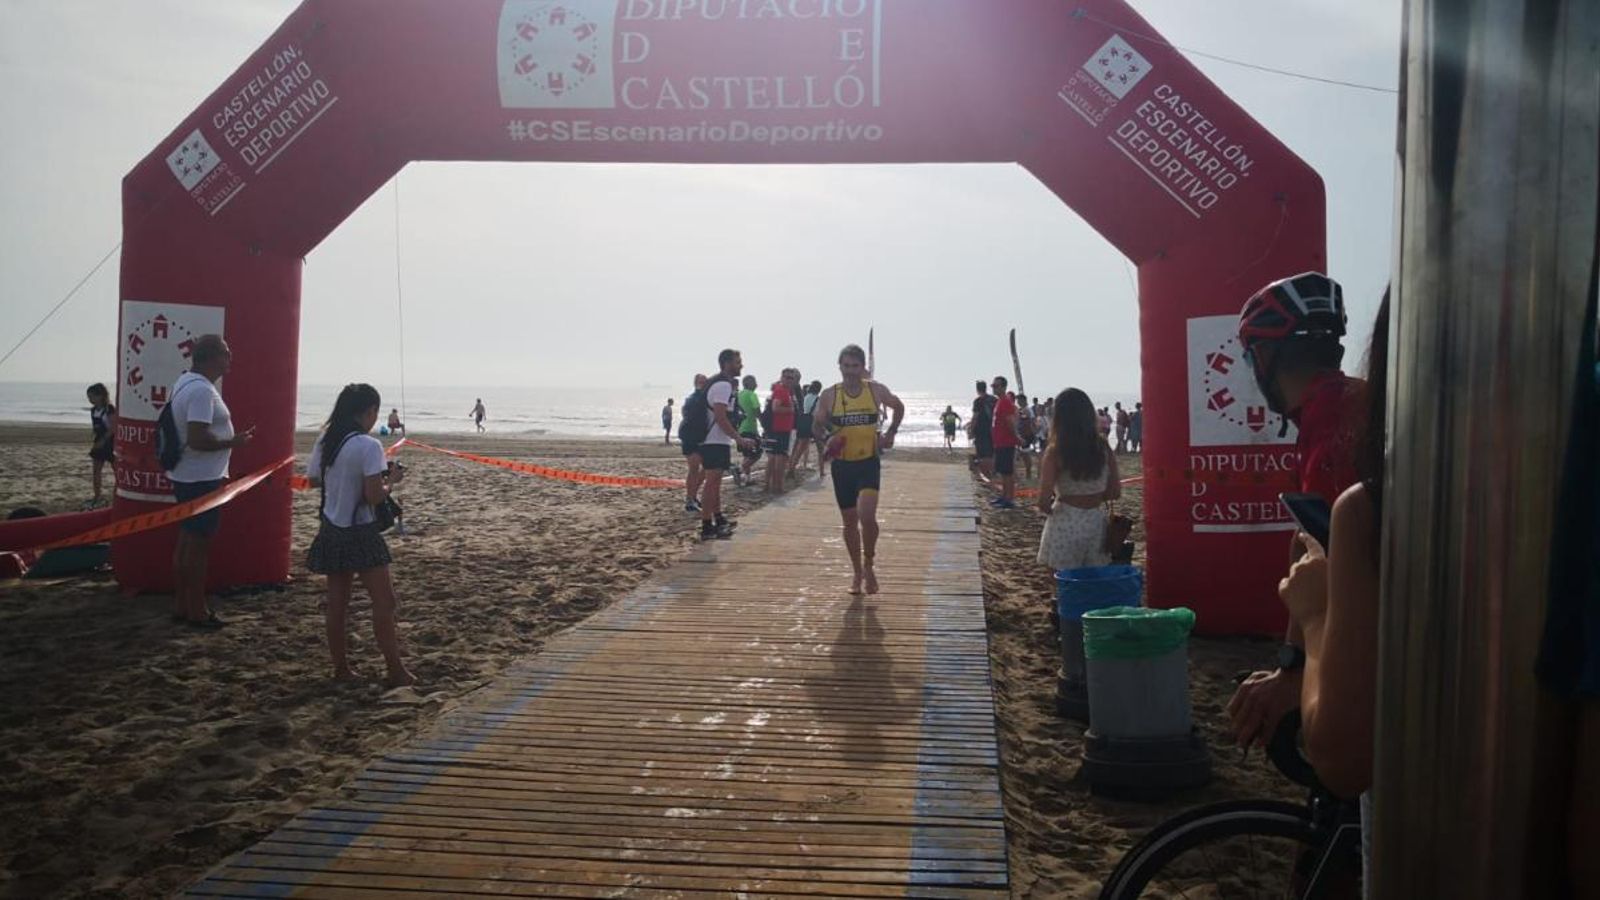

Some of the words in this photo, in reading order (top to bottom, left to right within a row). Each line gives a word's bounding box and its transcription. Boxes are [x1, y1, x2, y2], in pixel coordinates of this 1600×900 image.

[212, 44, 303, 129] CASTELLÓN,
[620, 32, 650, 63] D
[839, 29, 865, 61] E
[620, 65, 866, 110] CASTELLÓ
[223, 61, 312, 147] ESCENARIO
[240, 79, 330, 166] DEPORTIVO
[507, 119, 884, 144] #CSEscenarioDeportivo
[1136, 100, 1238, 190] ESCENARIO
[1153, 84, 1255, 177] CASTELLÓN,
[1116, 120, 1219, 210] DEPORTIVO
[1191, 502, 1292, 521] CASTEL
